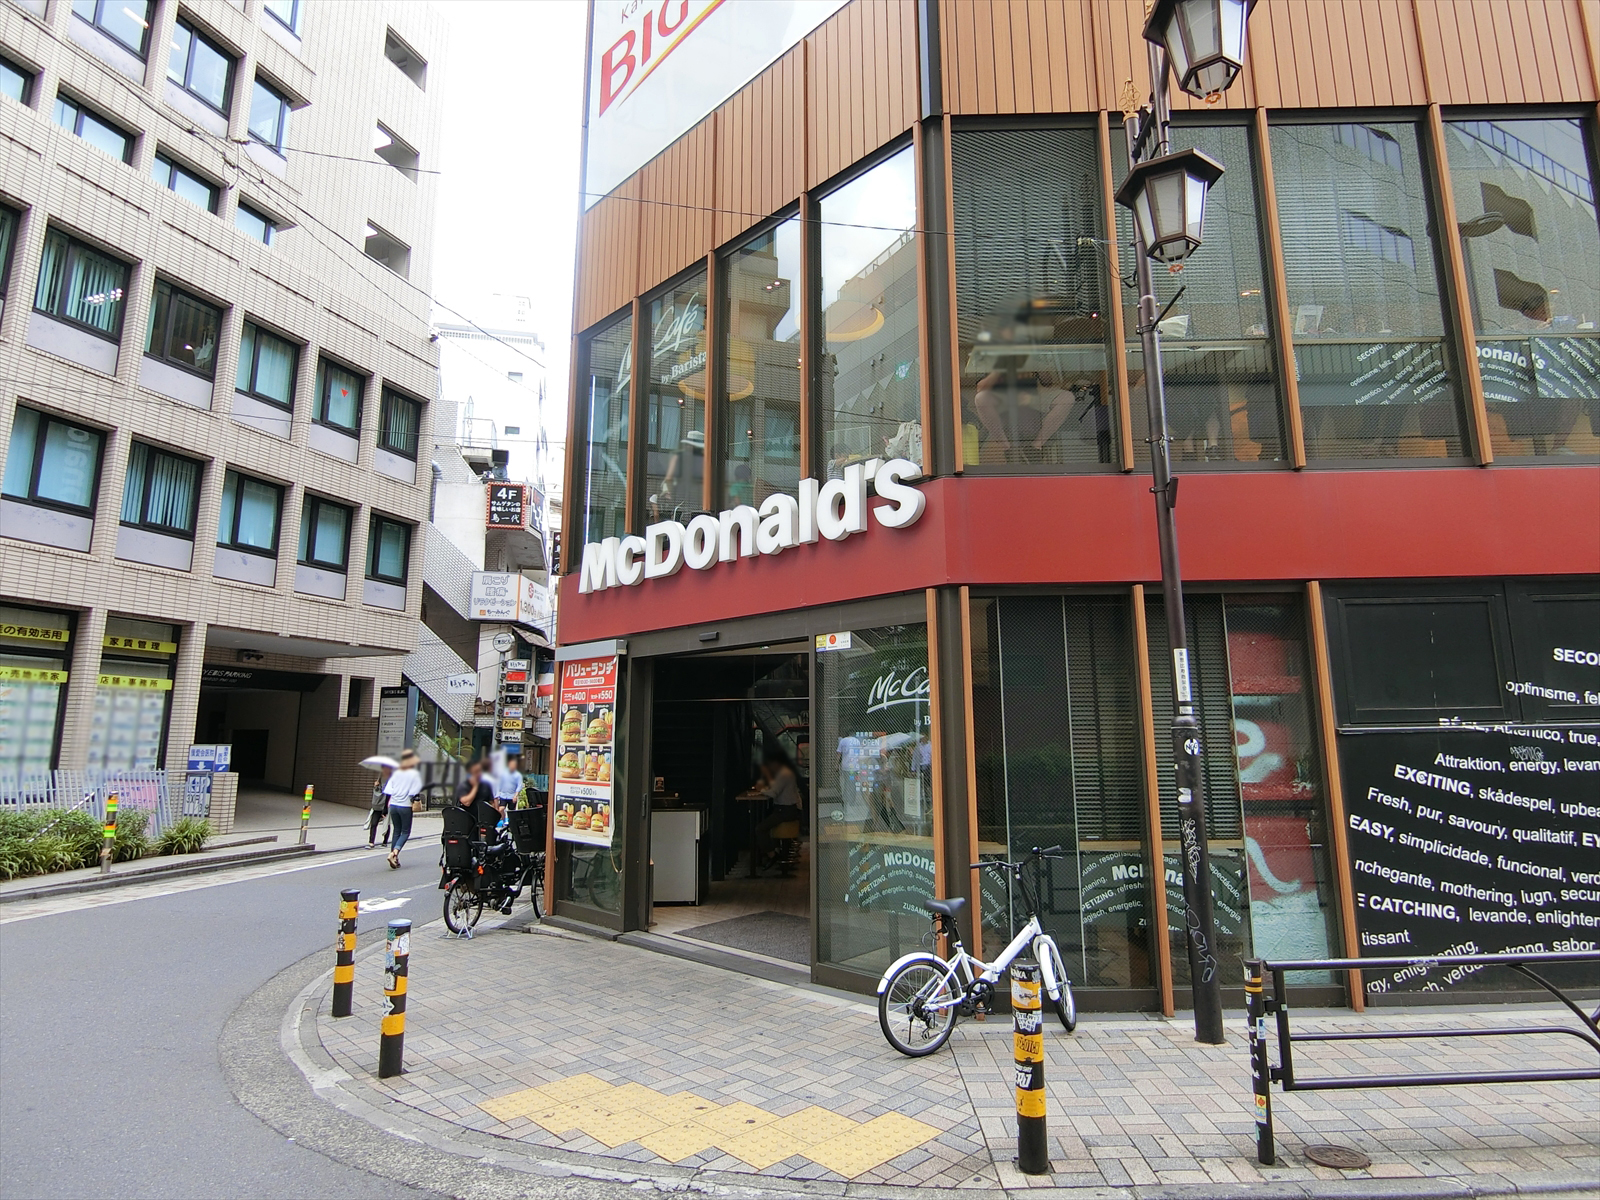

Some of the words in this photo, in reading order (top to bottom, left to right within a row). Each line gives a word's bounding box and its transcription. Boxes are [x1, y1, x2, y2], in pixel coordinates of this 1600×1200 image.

[621, 0, 644, 24] Ka
[496, 487, 518, 500] 4F
[579, 458, 925, 594] McDonald's
[0, 624, 63, 640] の有効活用
[109, 638, 161, 651] 家賃管理
[1553, 647, 1600, 667] SECO
[566, 660, 615, 678] バリューランチ
[100, 676, 159, 688] 店舗・事務所
[1433, 752, 1506, 774] Attraktion,
[1509, 760, 1562, 776] energy,
[1393, 763, 1475, 799] EXCITING,
[1478, 787, 1557, 814] skådespel,
[1367, 786, 1412, 815] Fresh,
[1416, 805, 1443, 824] pur,
[1447, 814, 1509, 841] savoury,
[1512, 828, 1577, 847] qualitatif,
[1349, 814, 1395, 843] EASY,
[1398, 832, 1493, 869] simplicidade,
[1496, 855, 1567, 883] funcional,
[1439, 881, 1518, 907] mothering,
[1520, 888, 1557, 906] lugn,
[1082, 909, 1108, 925] agisch,
[1369, 895, 1461, 923] CATCHING,
[1469, 907, 1532, 925] levande,
[1552, 937, 1597, 952] sabor
